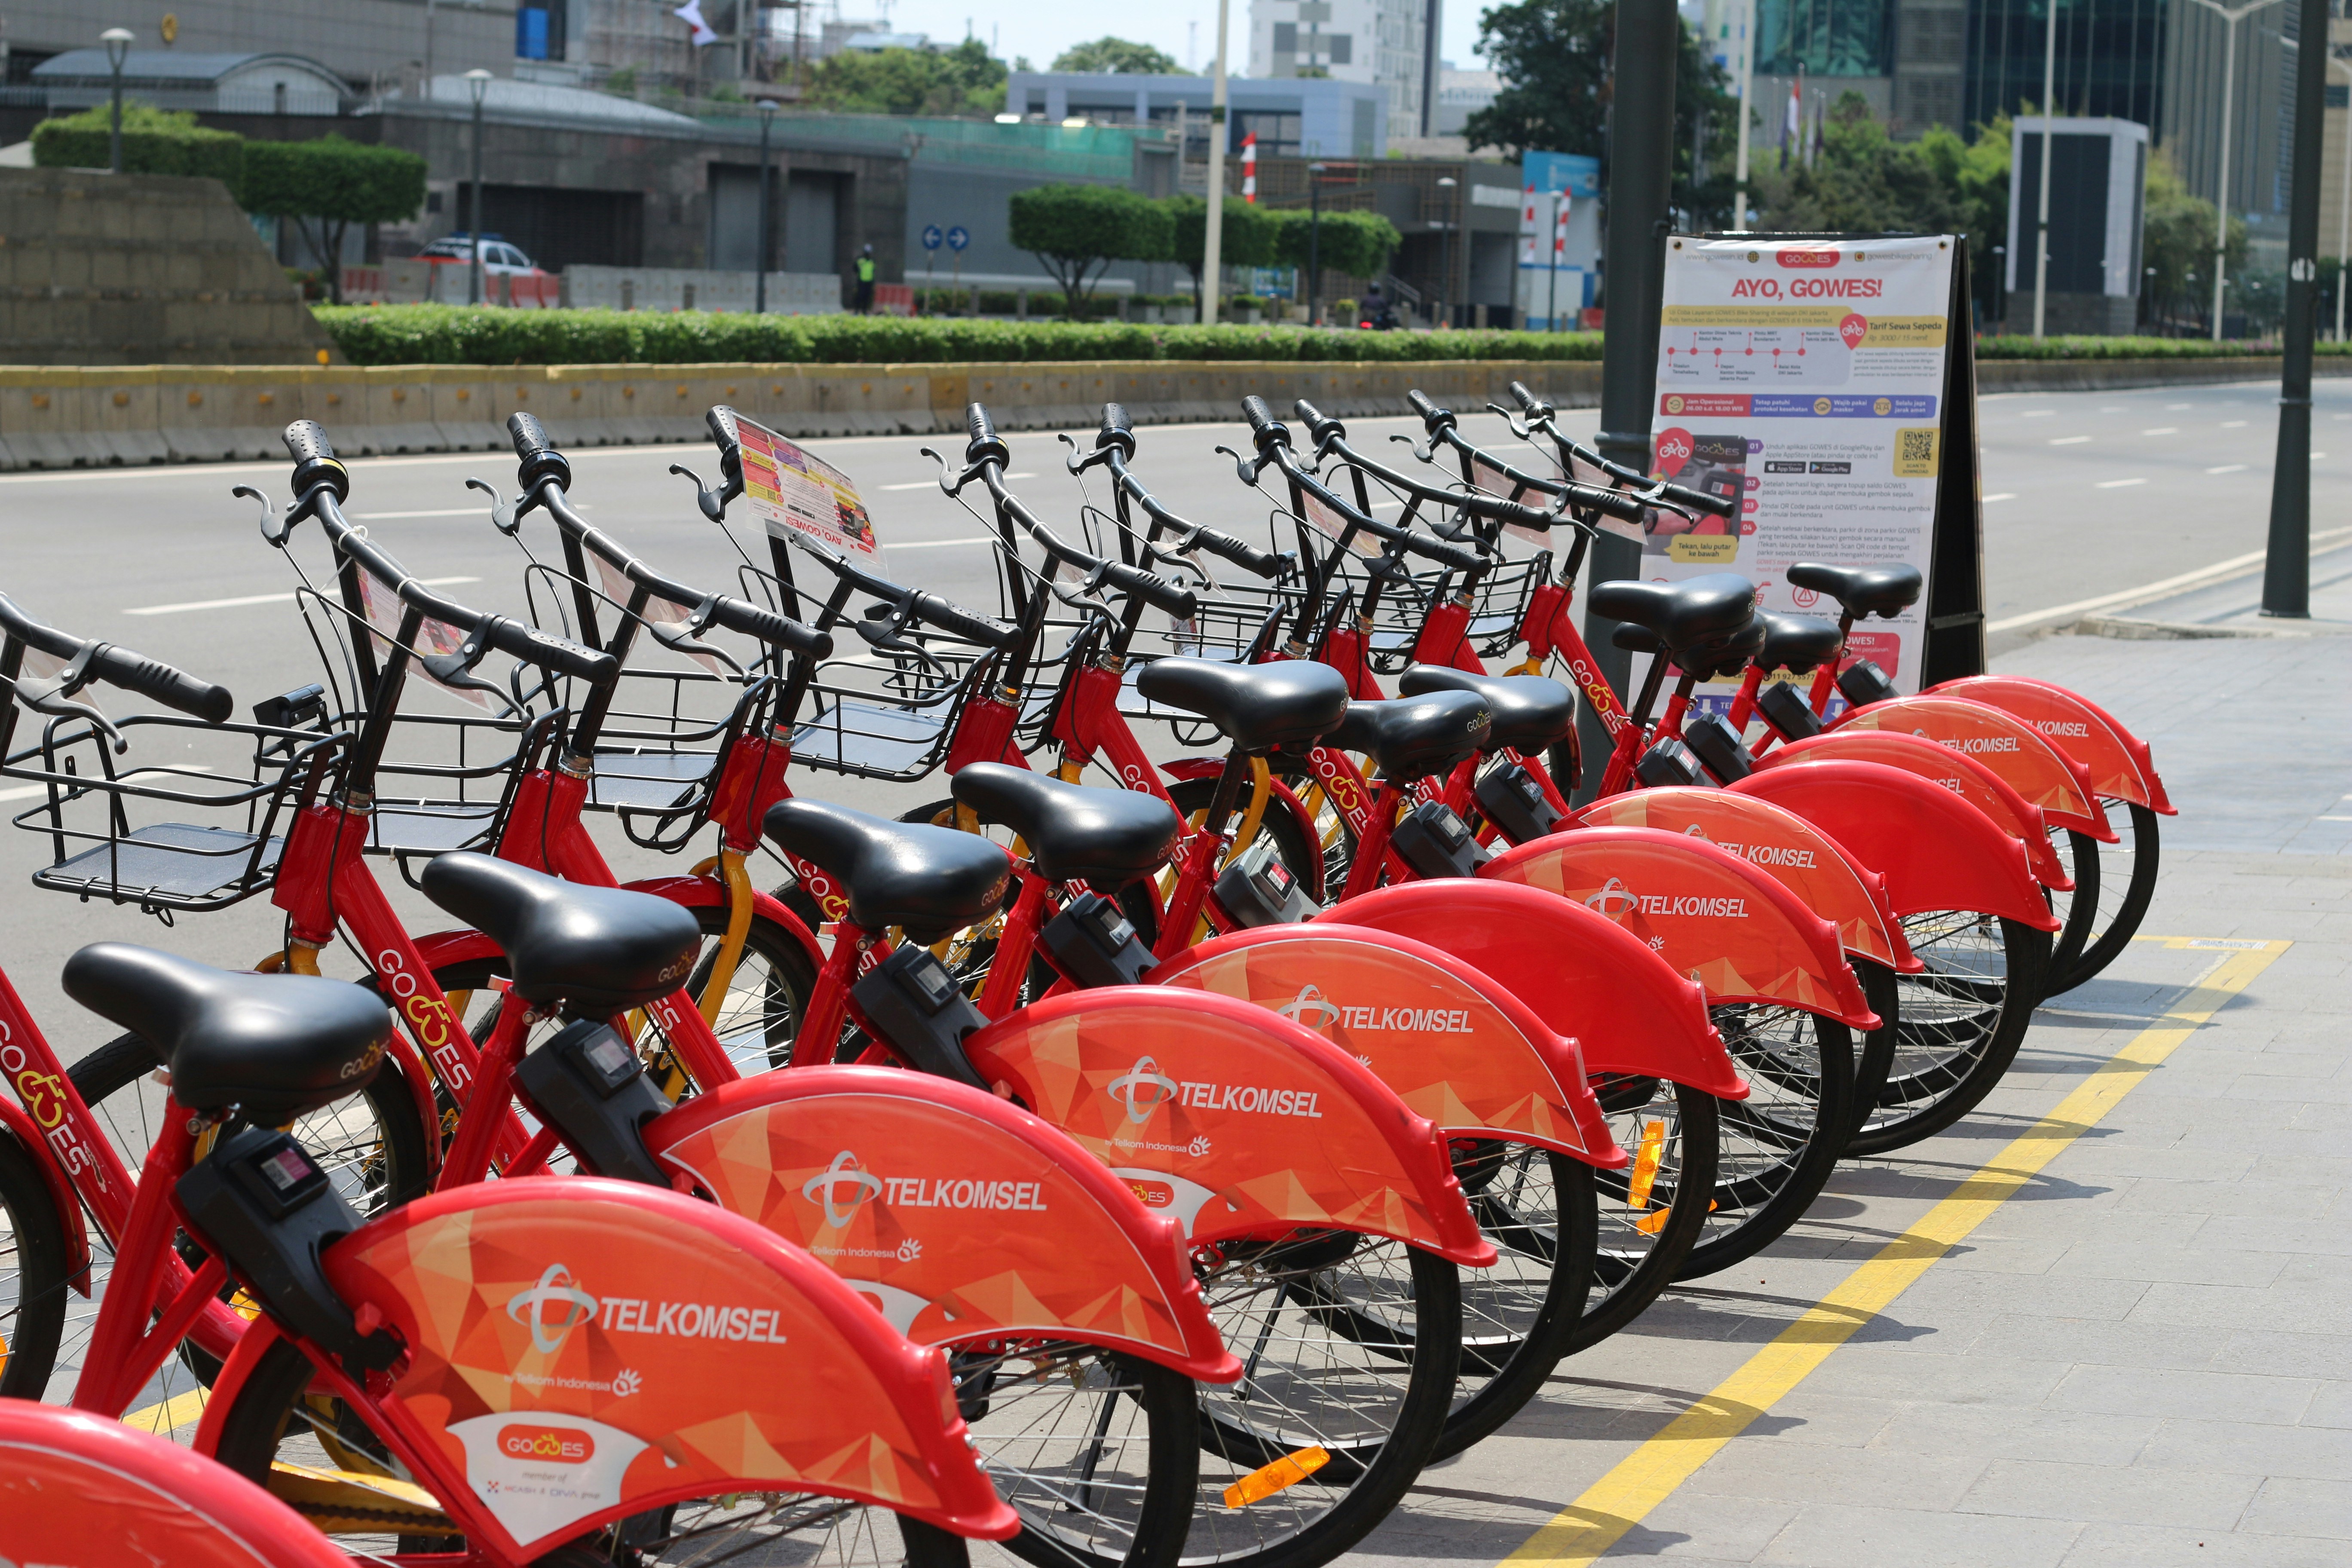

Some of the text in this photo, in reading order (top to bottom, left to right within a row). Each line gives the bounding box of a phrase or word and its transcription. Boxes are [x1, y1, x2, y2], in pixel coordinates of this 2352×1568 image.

[1785, 252, 1831, 263] GOWES
[1867, 252, 1932, 261] gowesbikesharing
[1731, 279, 1883, 301] AYO, GOWES!
[1913, 322, 1942, 331] Sepeda
[1695, 443, 1740, 456] GOWES
[785, 515, 821, 535] GOWES!
[819, 527, 842, 545] AYO,
[1573, 659, 1622, 735] GOWES
[1640, 895, 1749, 918] TELKOMSEL
[378, 949, 472, 1090] GOWES
[1341, 1006, 1474, 1033] TELKOMSEL
[1179, 1081, 1323, 1118] TELKOMSEL
[1113, 1138, 1144, 1149] Telkom
[1145, 1140, 1187, 1153] Indonesia
[884, 1177, 1047, 1211] TELKOMSEL
[812, 1246, 895, 1259] Telkom Indonesia
[601, 1297, 787, 1344] TELKOMSEL
[515, 1373, 554, 1387] Telkom
[556, 1376, 611, 1392] Indonesia
[507, 1433, 584, 1458] GOWES
[522, 1471, 568, 1482] member of
